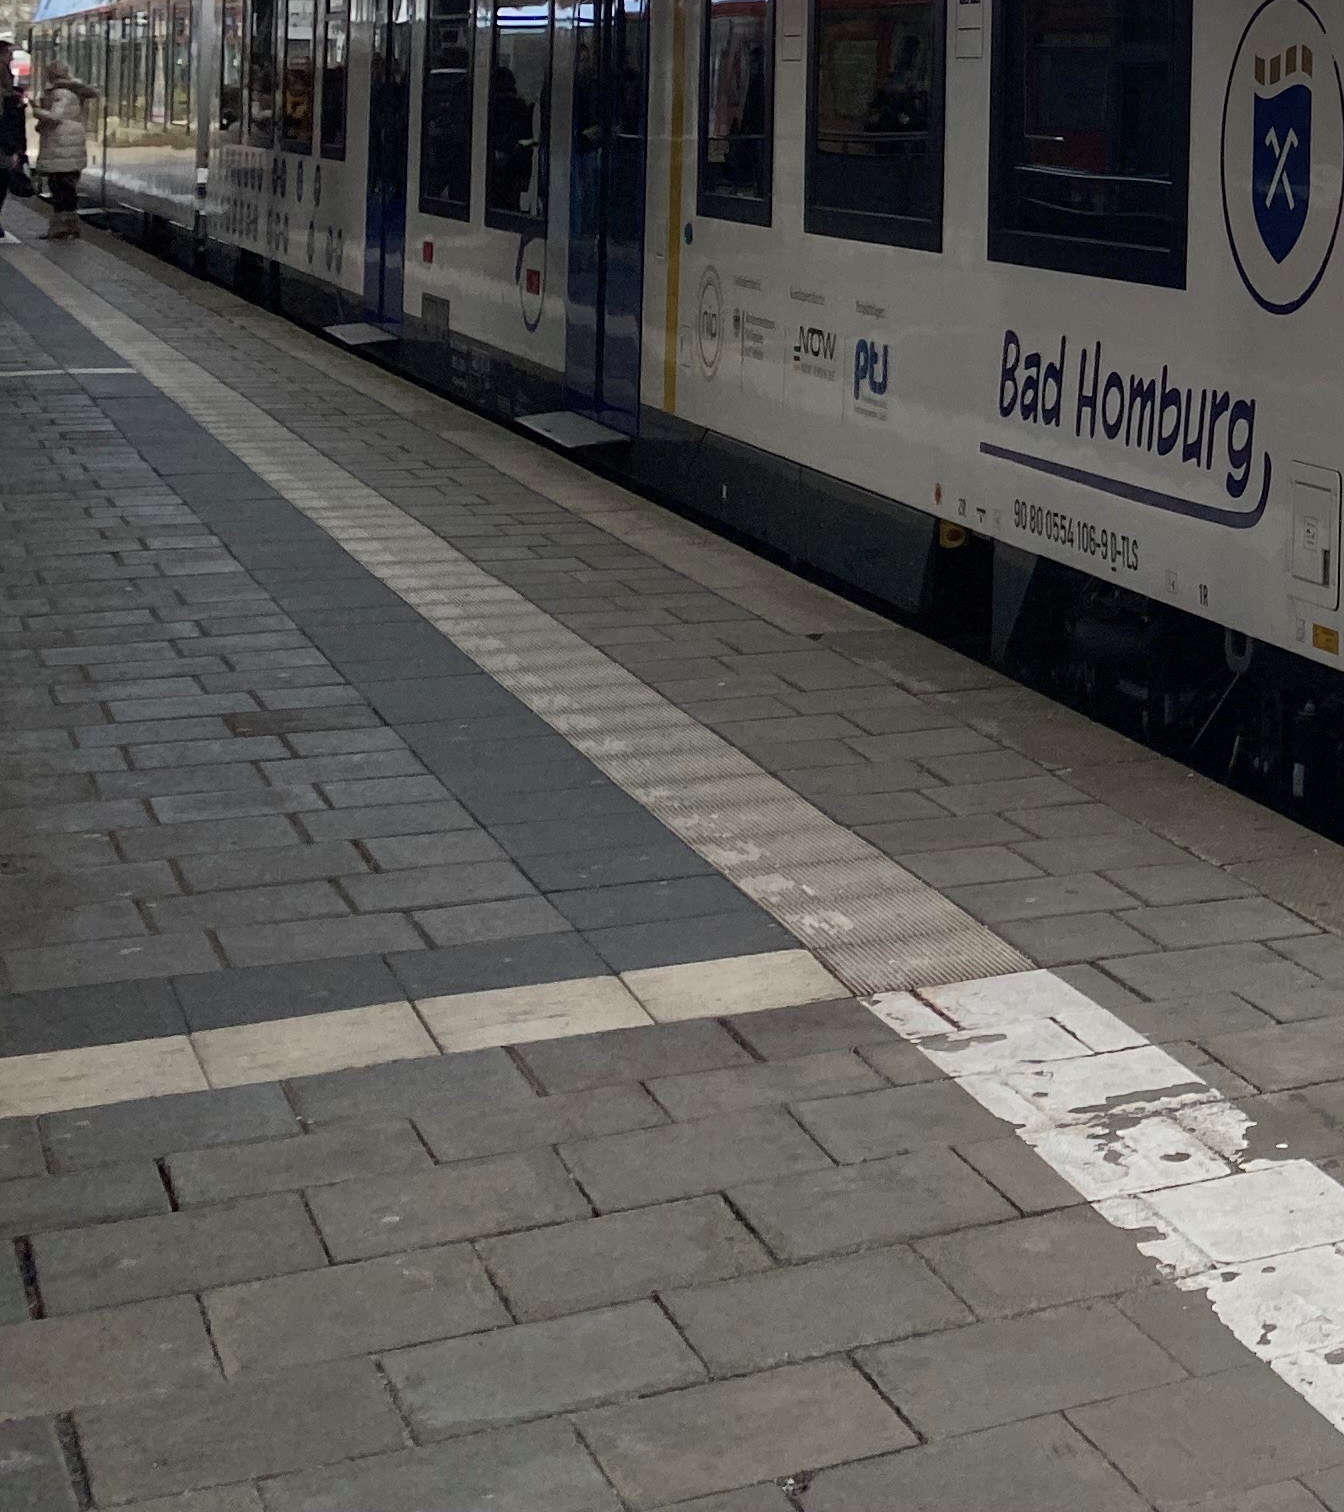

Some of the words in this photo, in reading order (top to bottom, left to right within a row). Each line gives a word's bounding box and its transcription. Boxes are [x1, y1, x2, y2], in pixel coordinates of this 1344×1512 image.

[1000, 329, 1067, 427] Bad
[1076, 340, 1256, 498] Homburg
[1014, 499, 1027, 530] 90
[1029, 504, 1043, 536] 80
[1046, 510, 1073, 548] 0554
[1077, 521, 1108, 560] 106-9
